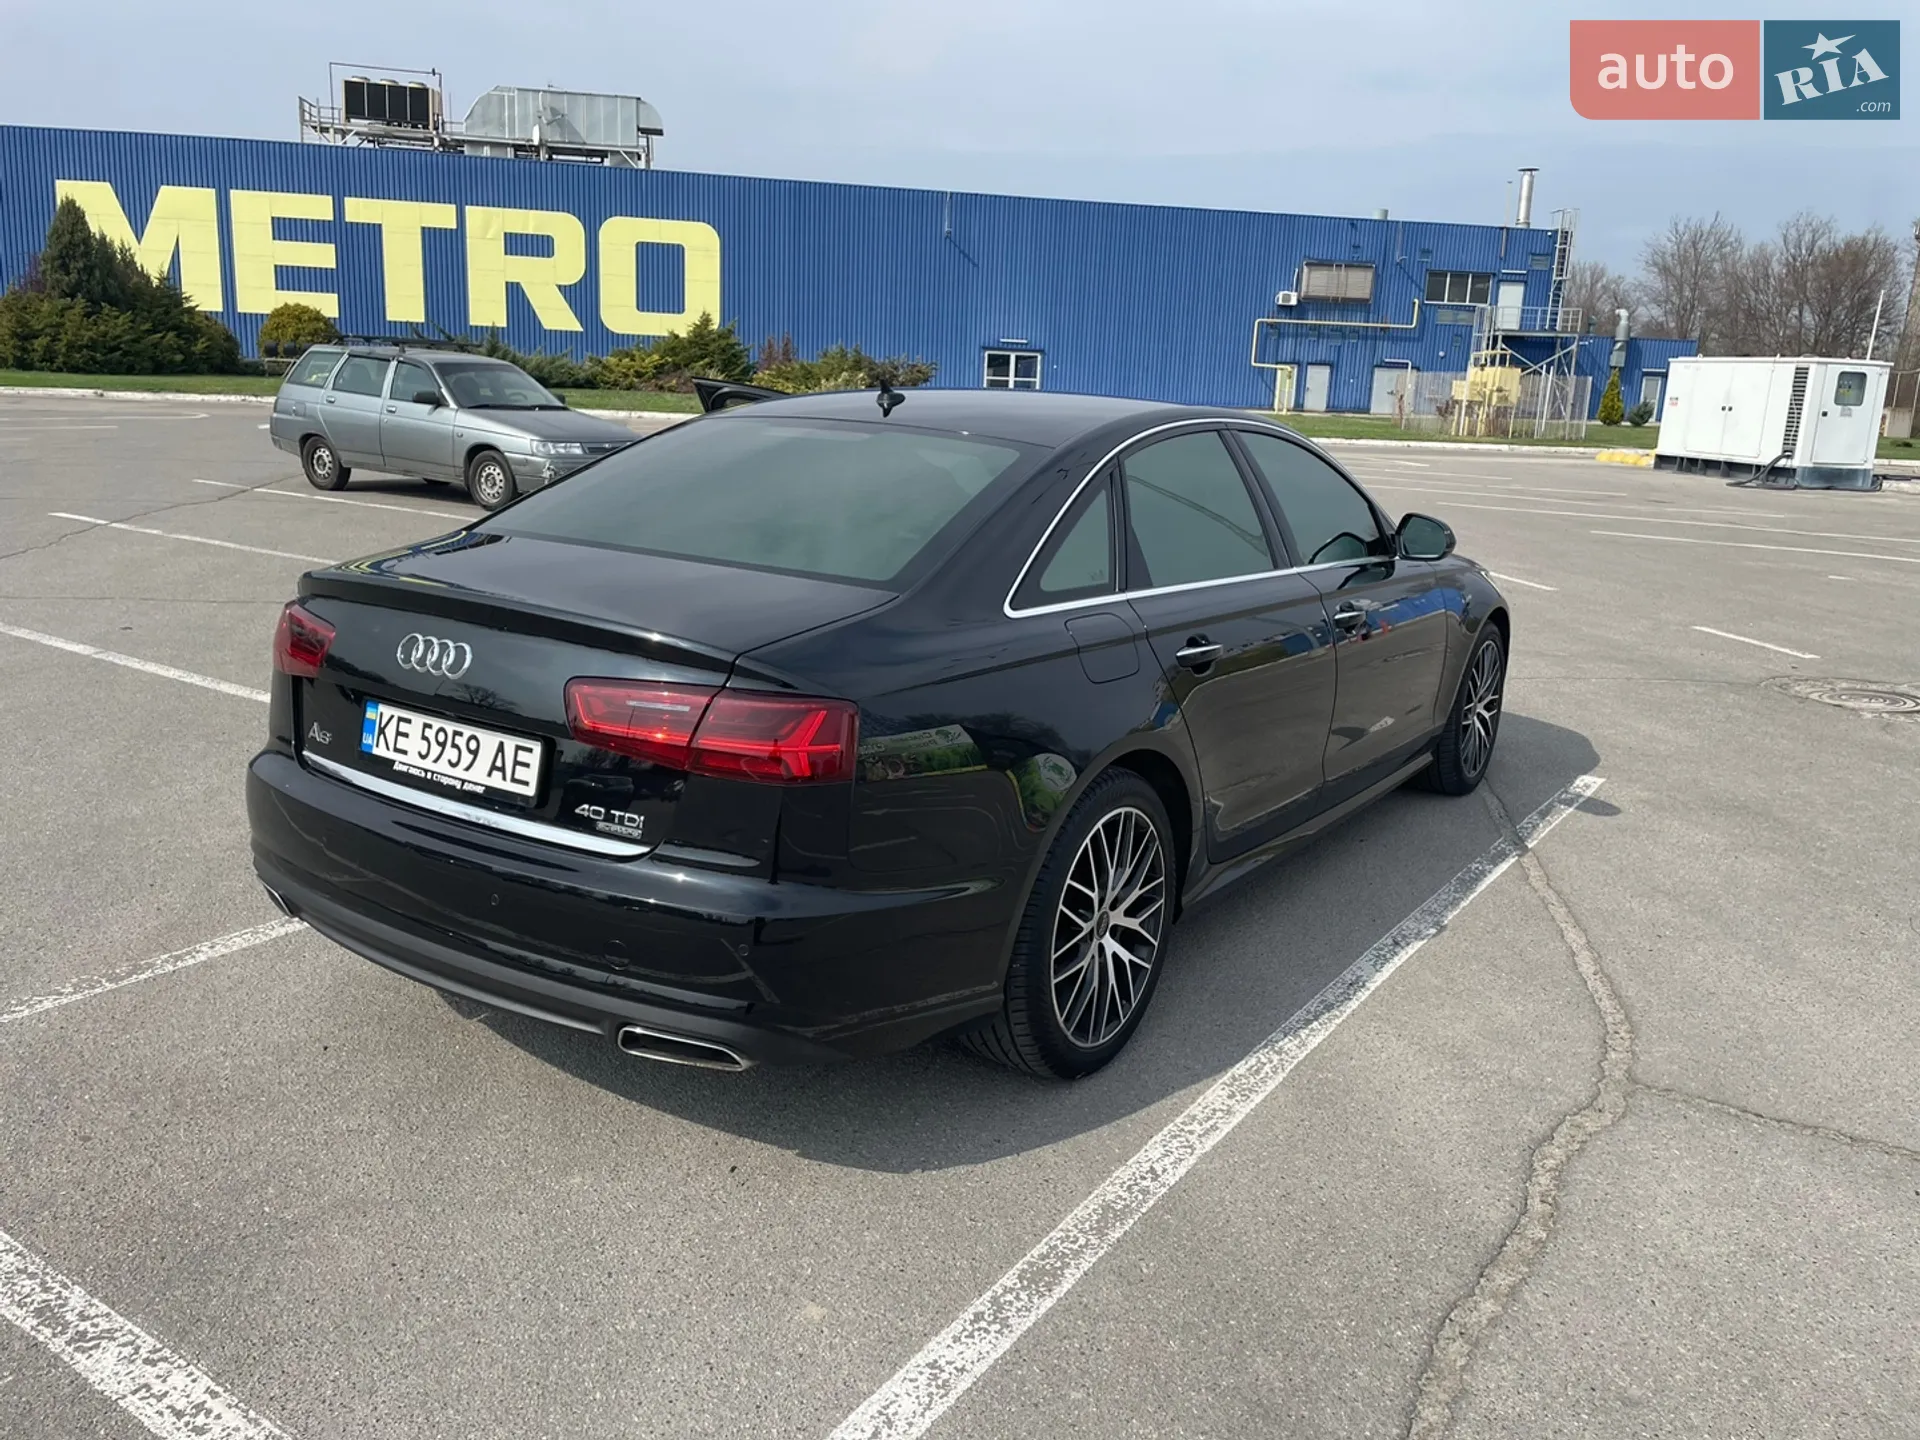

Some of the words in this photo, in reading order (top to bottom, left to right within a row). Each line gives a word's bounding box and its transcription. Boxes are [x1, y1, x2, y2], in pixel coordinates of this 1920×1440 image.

[56, 180, 720, 336] METRO
[362, 733, 373, 744] UA
[375, 711, 412, 756] KE
[417, 722, 480, 772] 5959
[486, 740, 533, 787] AE
[574, 803, 605, 820] 40
[610, 809, 645, 829] TDI
